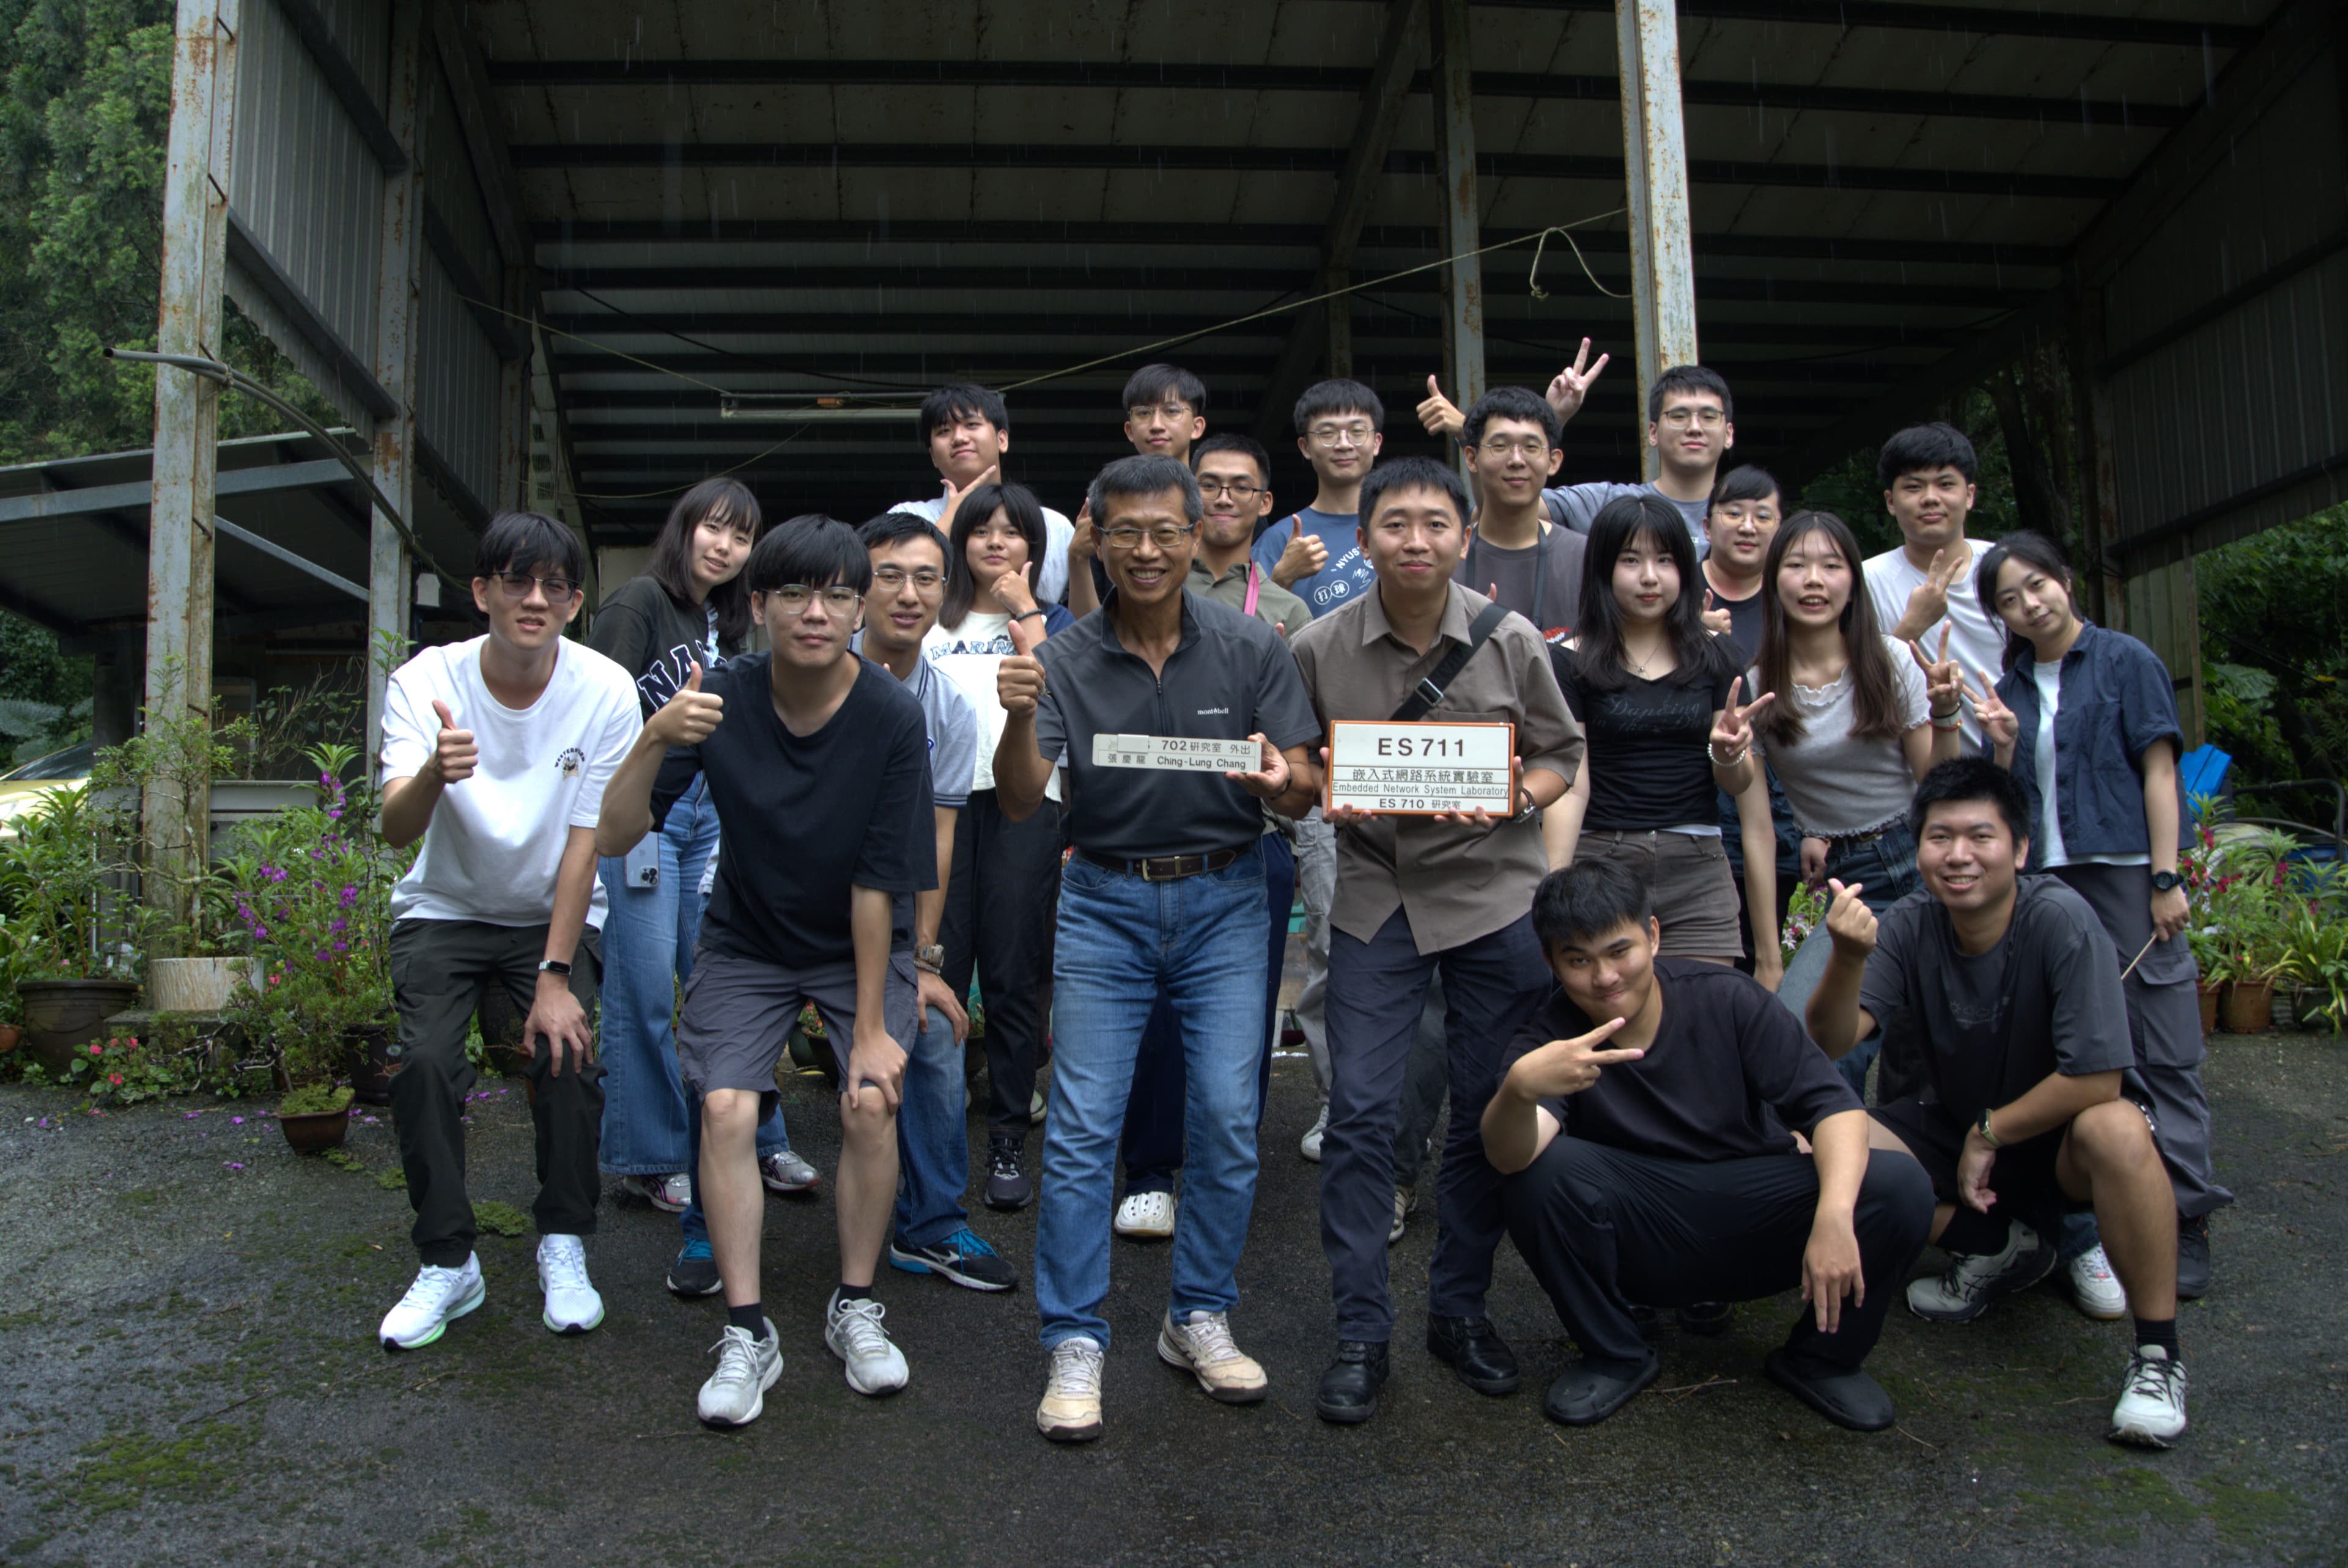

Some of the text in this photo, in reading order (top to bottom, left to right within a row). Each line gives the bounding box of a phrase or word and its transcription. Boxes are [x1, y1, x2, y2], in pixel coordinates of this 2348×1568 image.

[1335, 547, 1360, 569] NYUS
[1230, 744, 1250, 754] 外出
[1157, 756, 1212, 768] Ching-Lung
[1217, 759, 1246, 770] Chang
[1353, 768, 1493, 783] 嵌入式網路系統實驗室
[1333, 782, 1508, 798] Embedded Network System Laboratory
[1431, 800, 1461, 810] 研究室
